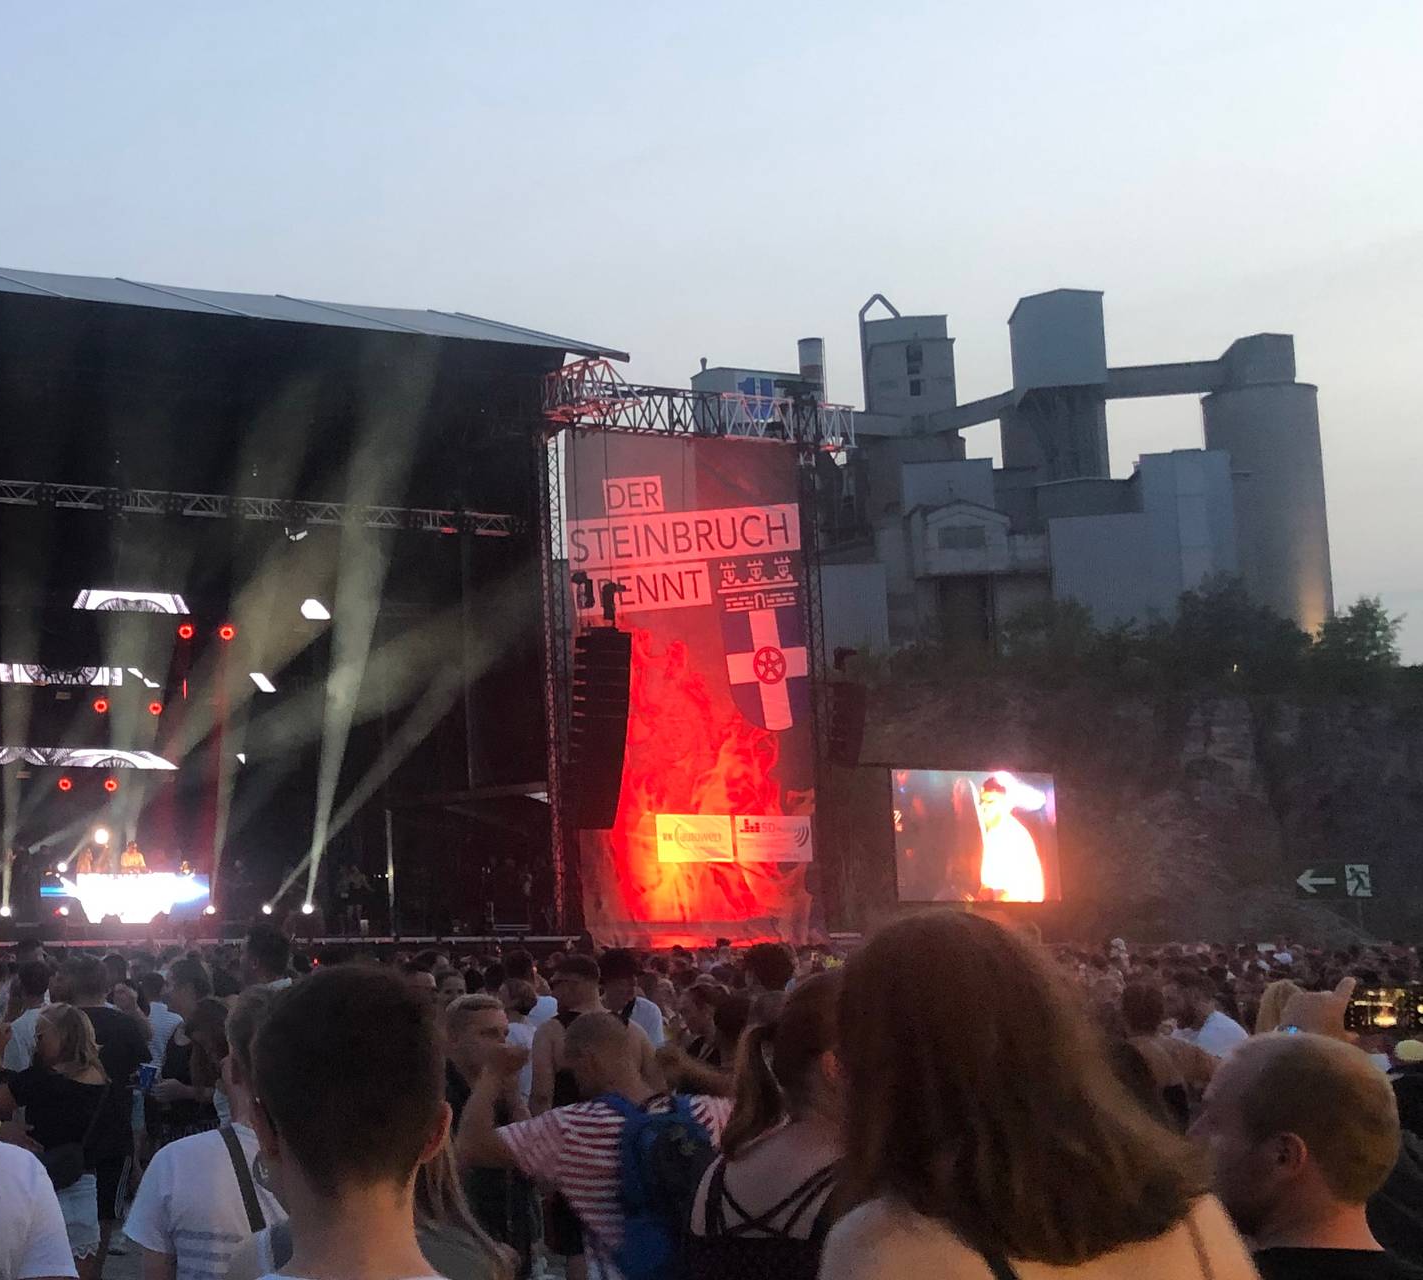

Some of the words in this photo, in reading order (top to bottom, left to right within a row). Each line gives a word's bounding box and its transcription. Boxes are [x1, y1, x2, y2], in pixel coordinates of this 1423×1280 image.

[606, 480, 661, 510] DER
[570, 511, 790, 563] STEINBRUCH
[577, 569, 703, 609] RENNT
